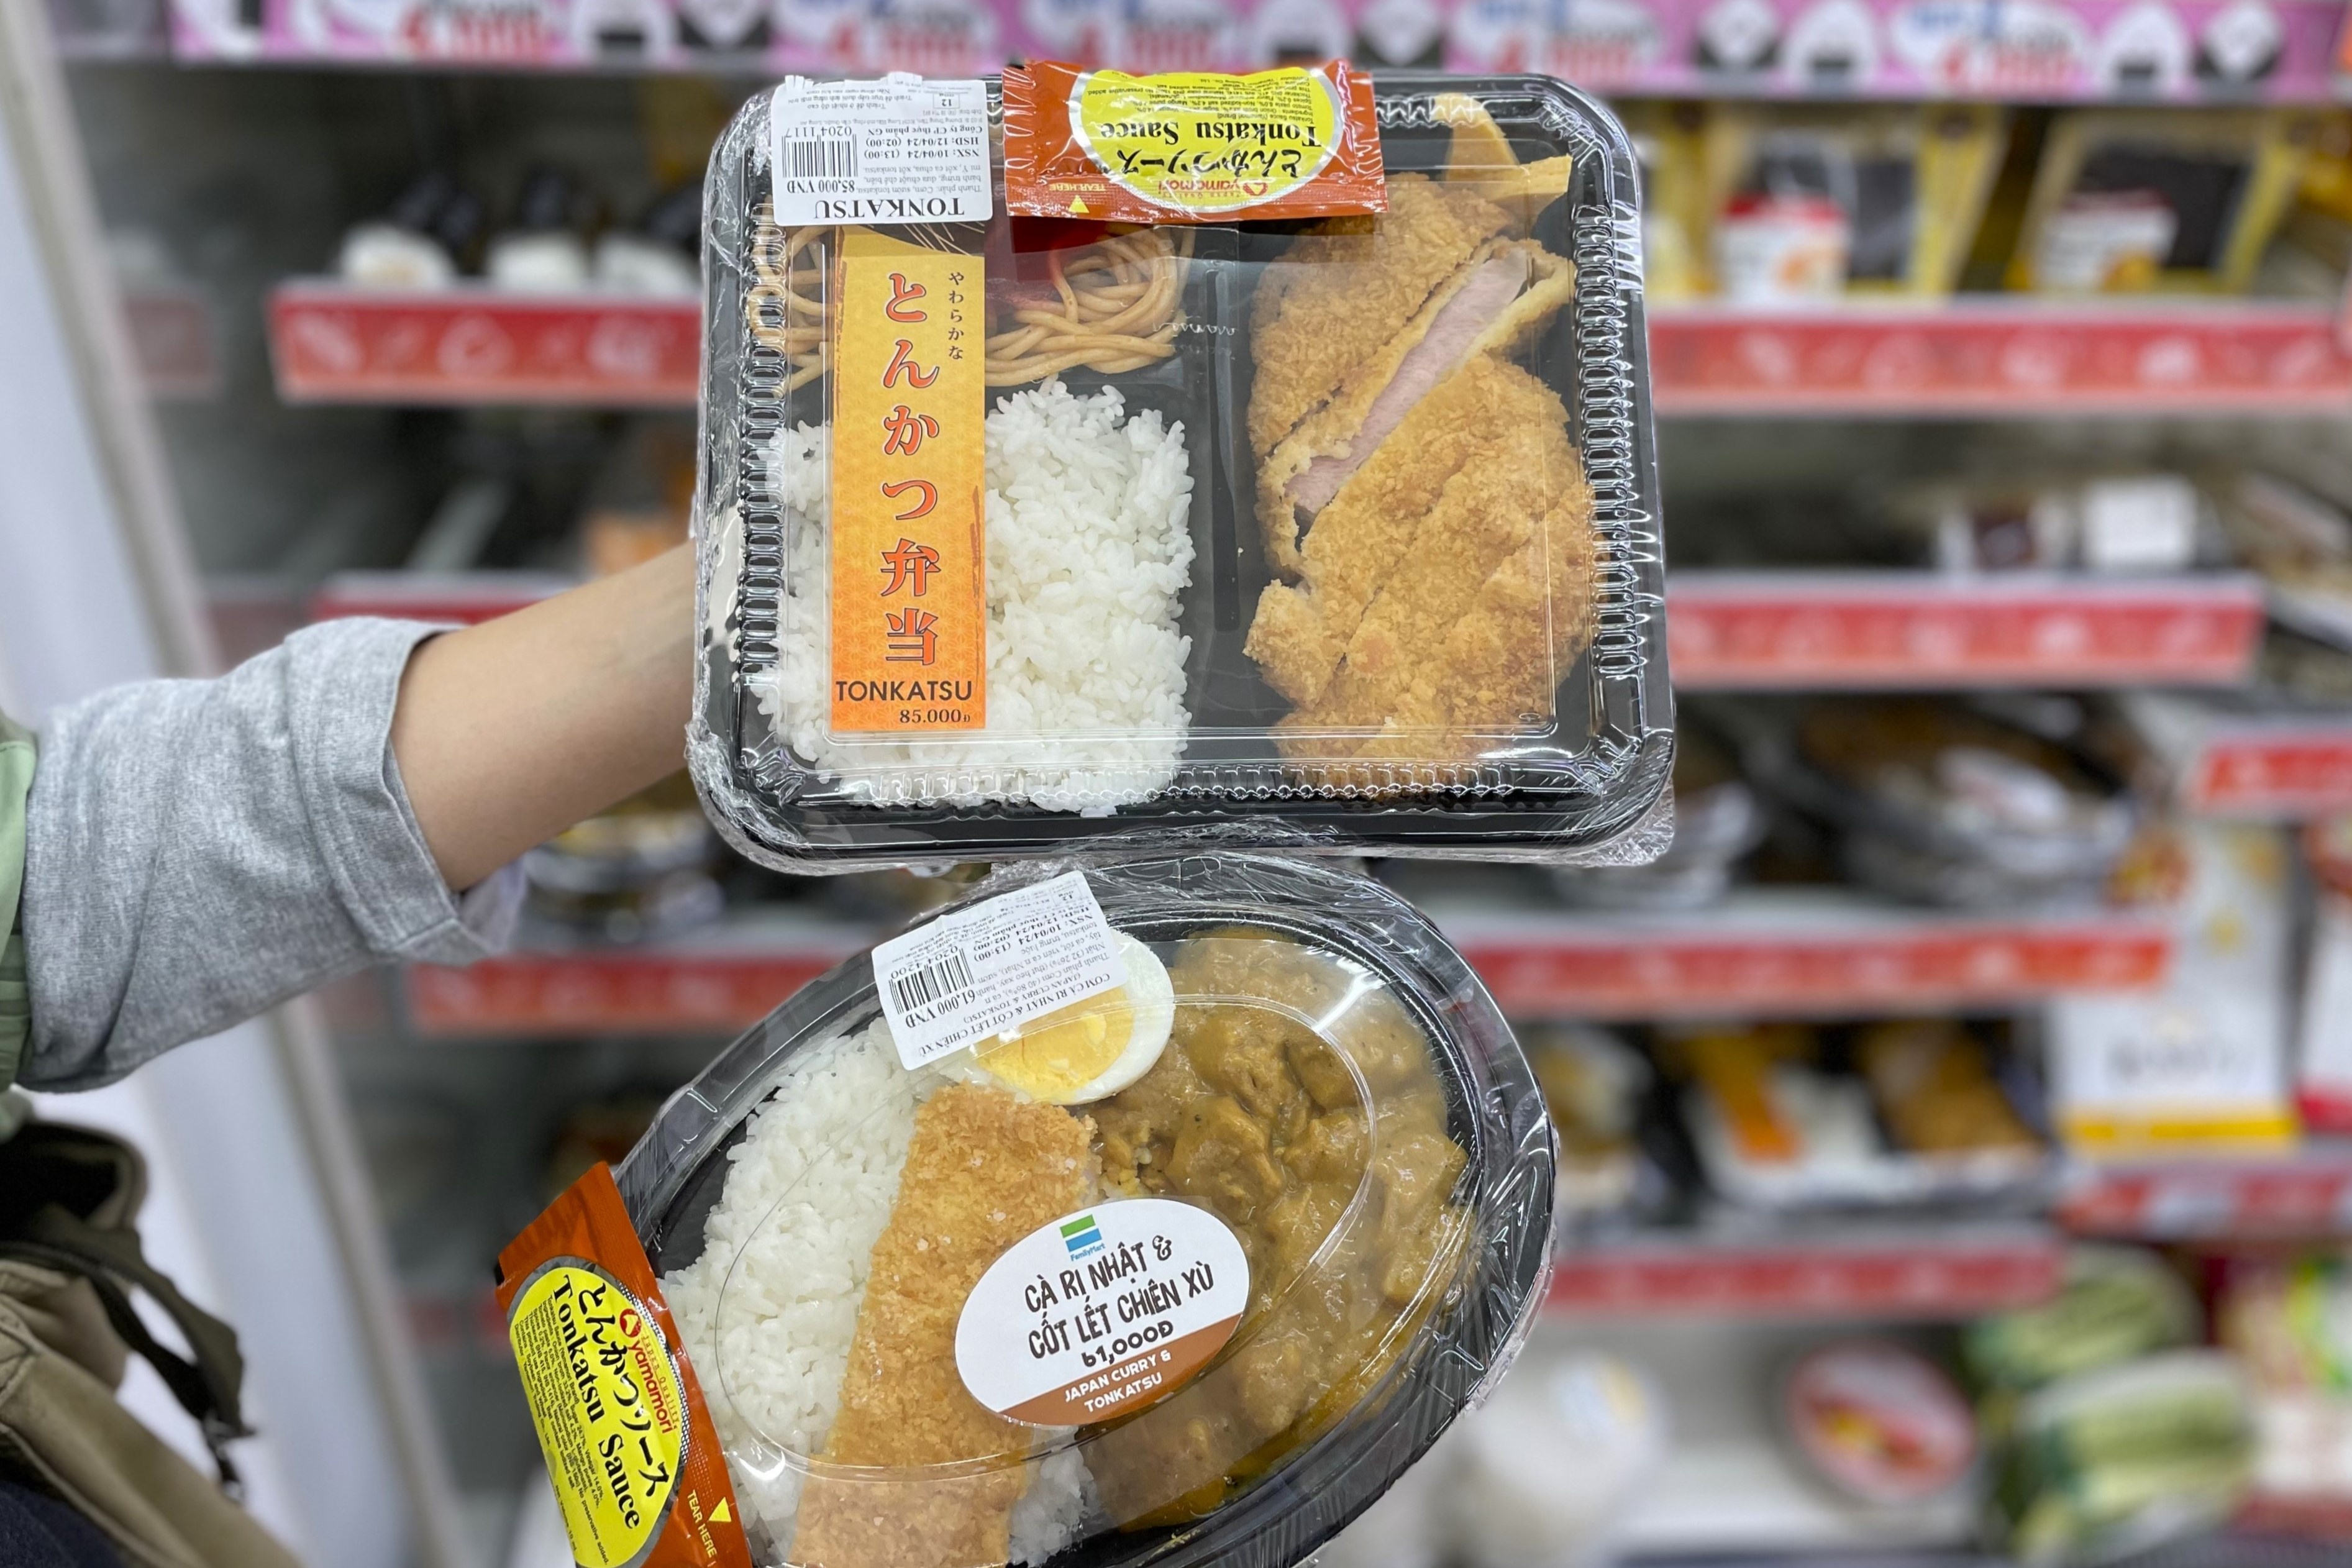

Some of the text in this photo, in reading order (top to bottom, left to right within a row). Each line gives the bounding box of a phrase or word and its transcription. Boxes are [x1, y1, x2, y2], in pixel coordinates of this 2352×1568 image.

[785, 125, 852, 137] 0204 1117
[886, 126, 909, 138] phẩm
[912, 125, 931, 134] thực
[960, 125, 982, 133] Công
[1101, 121, 1321, 147] Tonkatsu Sauce
[866, 137, 978, 147] HSD: 12/04/24 (02:00)
[864, 149, 900, 159] (13:00)
[908, 150, 948, 158] 10/04/24
[1117, 149, 1301, 180] とんかつソース
[786, 179, 855, 193] 85,000 VNĐ
[1049, 183, 1106, 191] TEAR HERE
[1158, 176, 1241, 196] yamamori
[814, 197, 964, 219] TONKATSU
[947, 271, 965, 360] やわらかな
[880, 273, 941, 666] とんかつ弁当
[836, 681, 972, 701] TONKATSU
[1015, 917, 1057, 936] 12/04/24
[973, 913, 1092, 962] NSX: 10/04/24 (13:00)
[973, 933, 1010, 951] (02:00)
[890, 946, 958, 979] 0204 4200
[1015, 970, 1031, 982] heo
[1051, 973, 1081, 988] (JAPAN
[1085, 973, 1110, 988] CƠM
[1021, 985, 1050, 1000] CURRY
[1025, 994, 1054, 1011] NHẬT
[1055, 989, 1067, 999] RI
[905, 989, 976, 1028] 61,000 VNĐ
[963, 1000, 1011, 1023] TONKATSU)
[1015, 1006, 1023, 1014] &
[934, 1029, 969, 1049] CHIÊN
[1070, 1244, 1106, 1261] FamilyMart
[1025, 1236, 1171, 1312] CÀ RI NHẬT &
[1029, 1261, 1213, 1359] CỐT LẾT CHIÊN XÙ
[546, 1296, 558, 1326] Tonkatsu
[568, 1381, 580, 1405] Brand)
[1065, 1351, 1171, 1402] JAPAN CURRY &
[578, 1283, 669, 1497] とんかつソース
[632, 1342, 673, 1433] yamamori
[1085, 1372, 1162, 1411] TONKATSU
[551, 1341, 560, 1361] Onion
[557, 1361, 567, 1380] broth
[583, 1449, 596, 1476] Vinegar
[555, 1274, 639, 1529] Tonkatsu Sauce
[575, 1443, 588, 1467] Mango
[559, 1434, 569, 1451] color
[577, 1488, 585, 1498] No
[581, 1500, 599, 1539] preservative
[596, 1541, 610, 1566] added.
[687, 1490, 716, 1557] TEAR HERE
